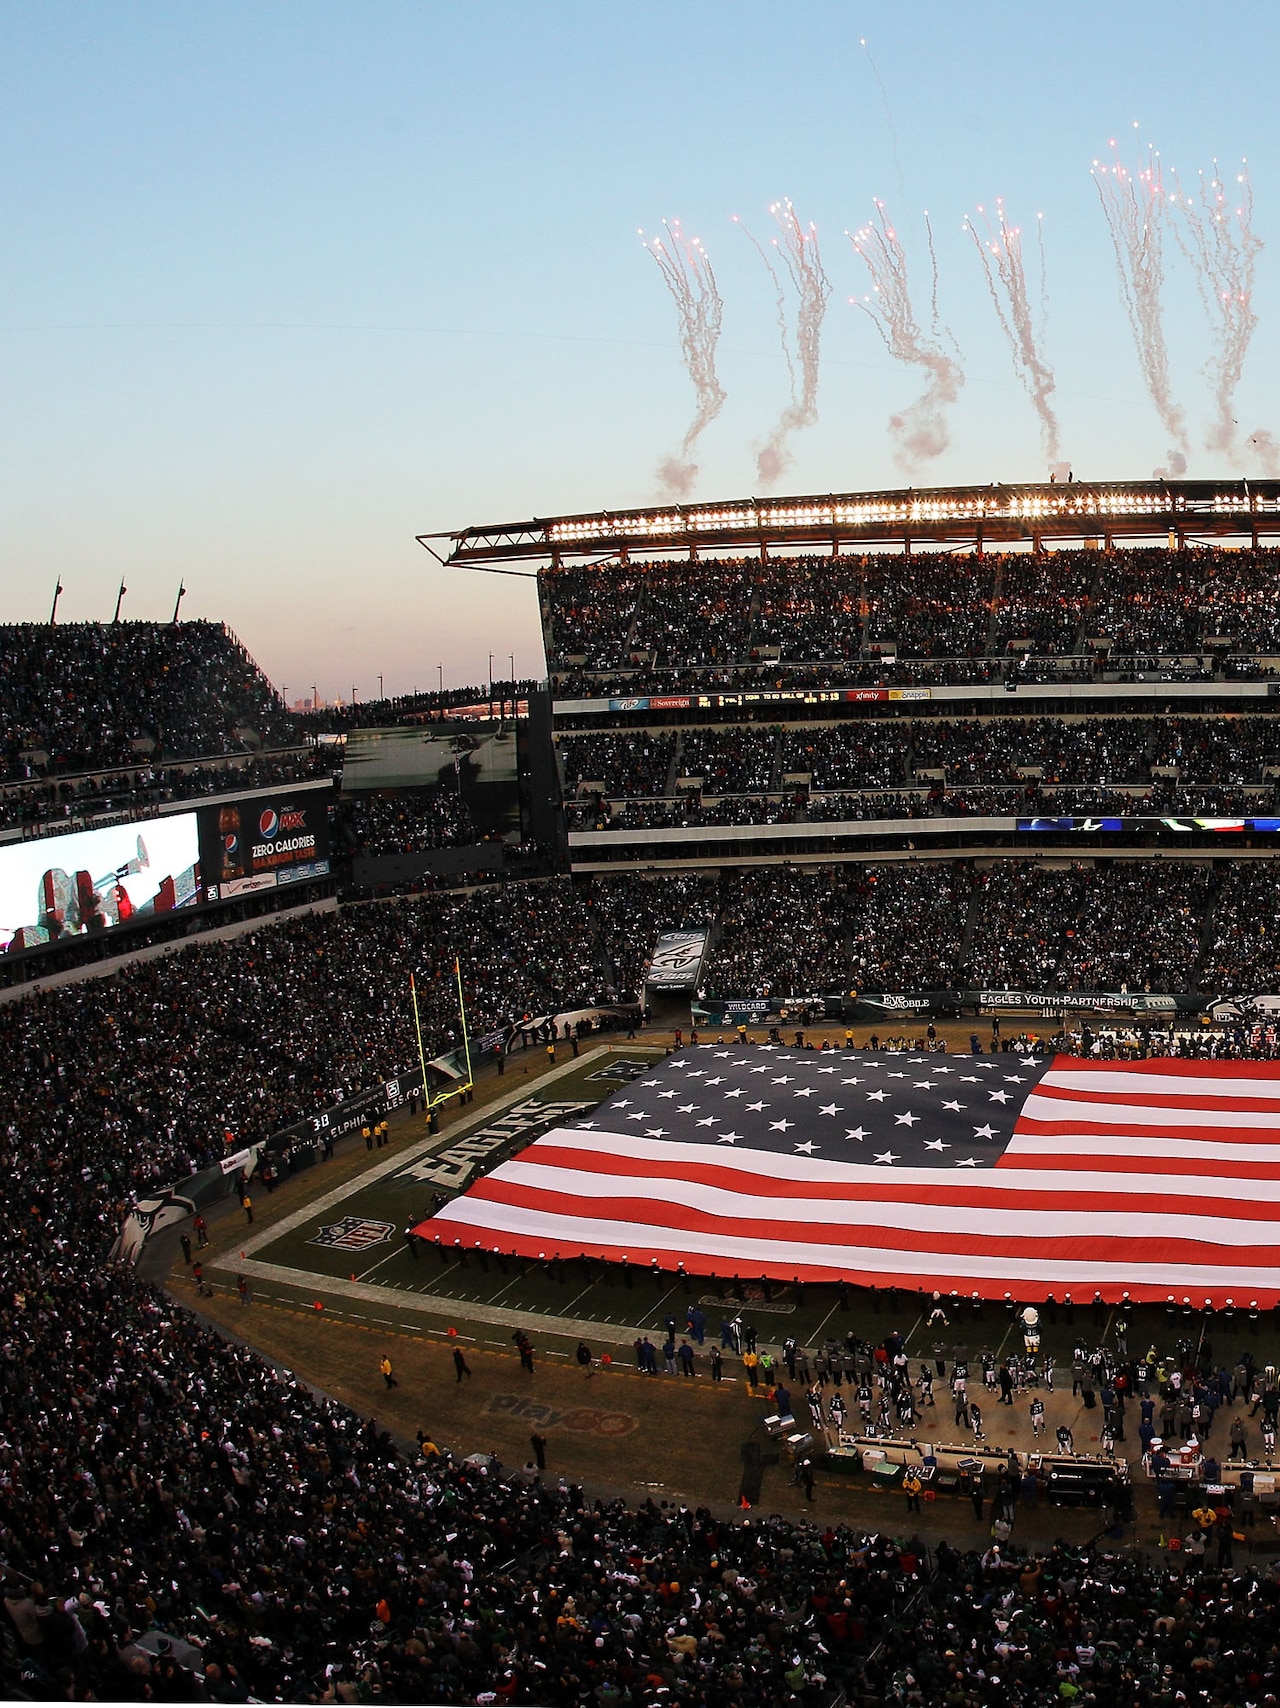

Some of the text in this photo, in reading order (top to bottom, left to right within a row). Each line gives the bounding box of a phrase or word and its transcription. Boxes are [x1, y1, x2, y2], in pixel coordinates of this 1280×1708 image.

[856, 690, 880, 701] xfinity
[901, 690, 930, 699] Snapple
[657, 699, 690, 708] Sovereign
[279, 810, 306, 831] MAX
[252, 834, 316, 858] ZERO CALORIES
[252, 850, 294, 871] MAXIMUM
[295, 846, 317, 862] TASTE
[980, 993, 1021, 1005] EAGLES
[728, 1002, 768, 1011] WILDCARD
[393, 1097, 598, 1190] EAGLES
